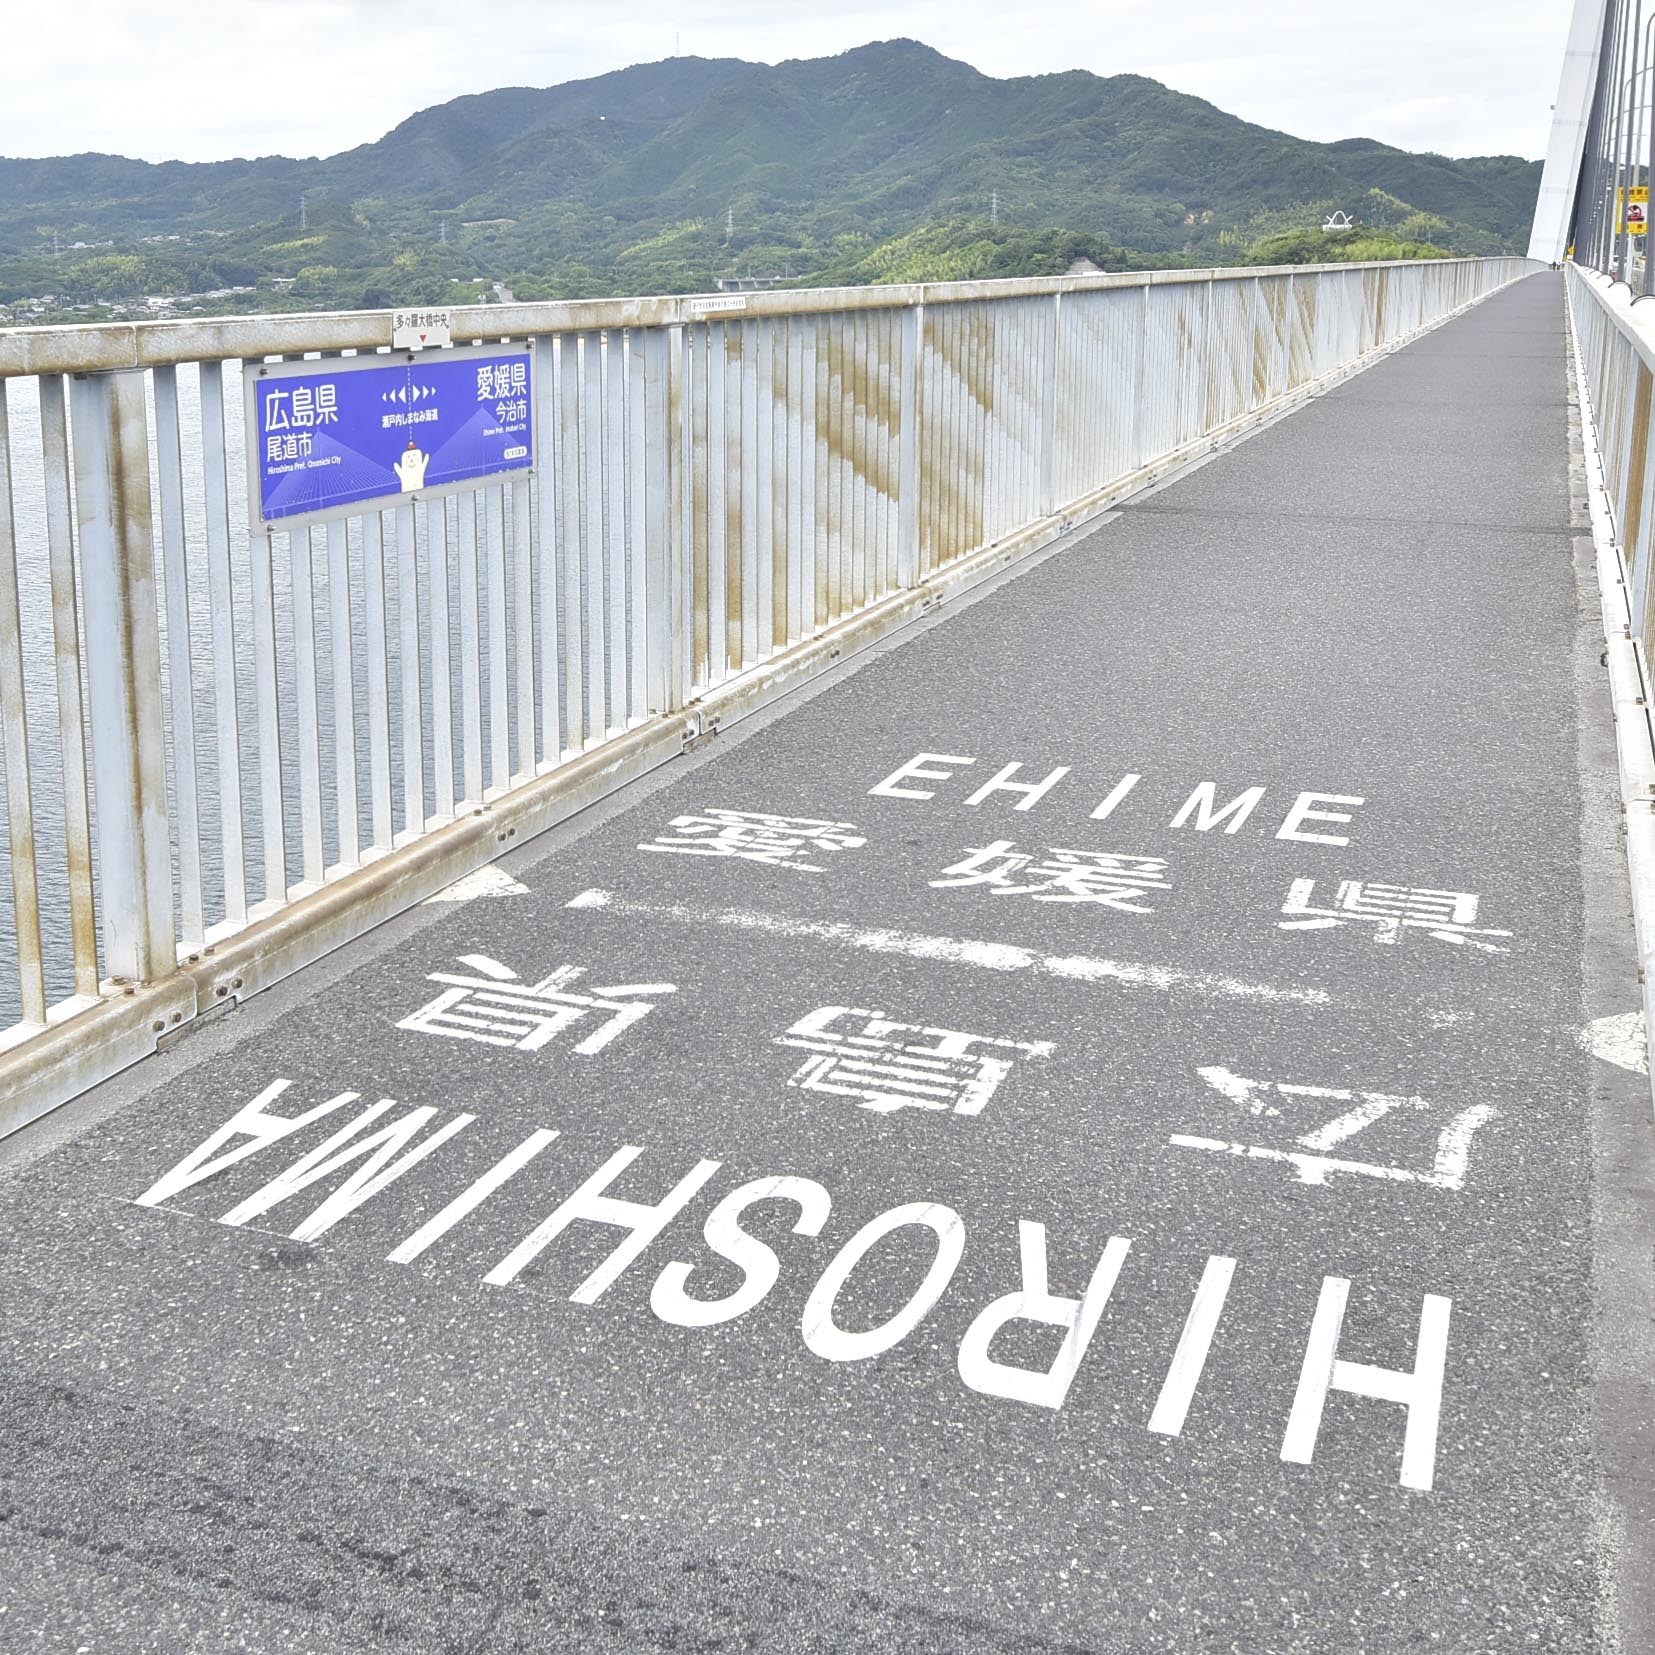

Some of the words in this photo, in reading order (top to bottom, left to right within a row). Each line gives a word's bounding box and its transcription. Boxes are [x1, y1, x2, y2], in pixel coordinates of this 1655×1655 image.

[396, 312, 449, 329] 多々羅大橋中央
[476, 363, 527, 402] 愛媛県
[264, 384, 339, 432] 広島県
[382, 408, 439, 429] 瀬戸内しまなみ海道
[495, 398, 527, 424] 今治市
[266, 431, 312, 462] 尾道市
[267, 464, 294, 475] Hiroshima
[294, 460, 307, 471] Pref.
[307, 456, 331, 468] Onomichi
[331, 455, 342, 465] City
[868, 753, 1364, 847] EHIME
[636, 808, 1514, 954] 愛媛県
[396, 953, 1498, 1191] 広島県
[134, 1079, 1451, 1491] HIROSHIMA
